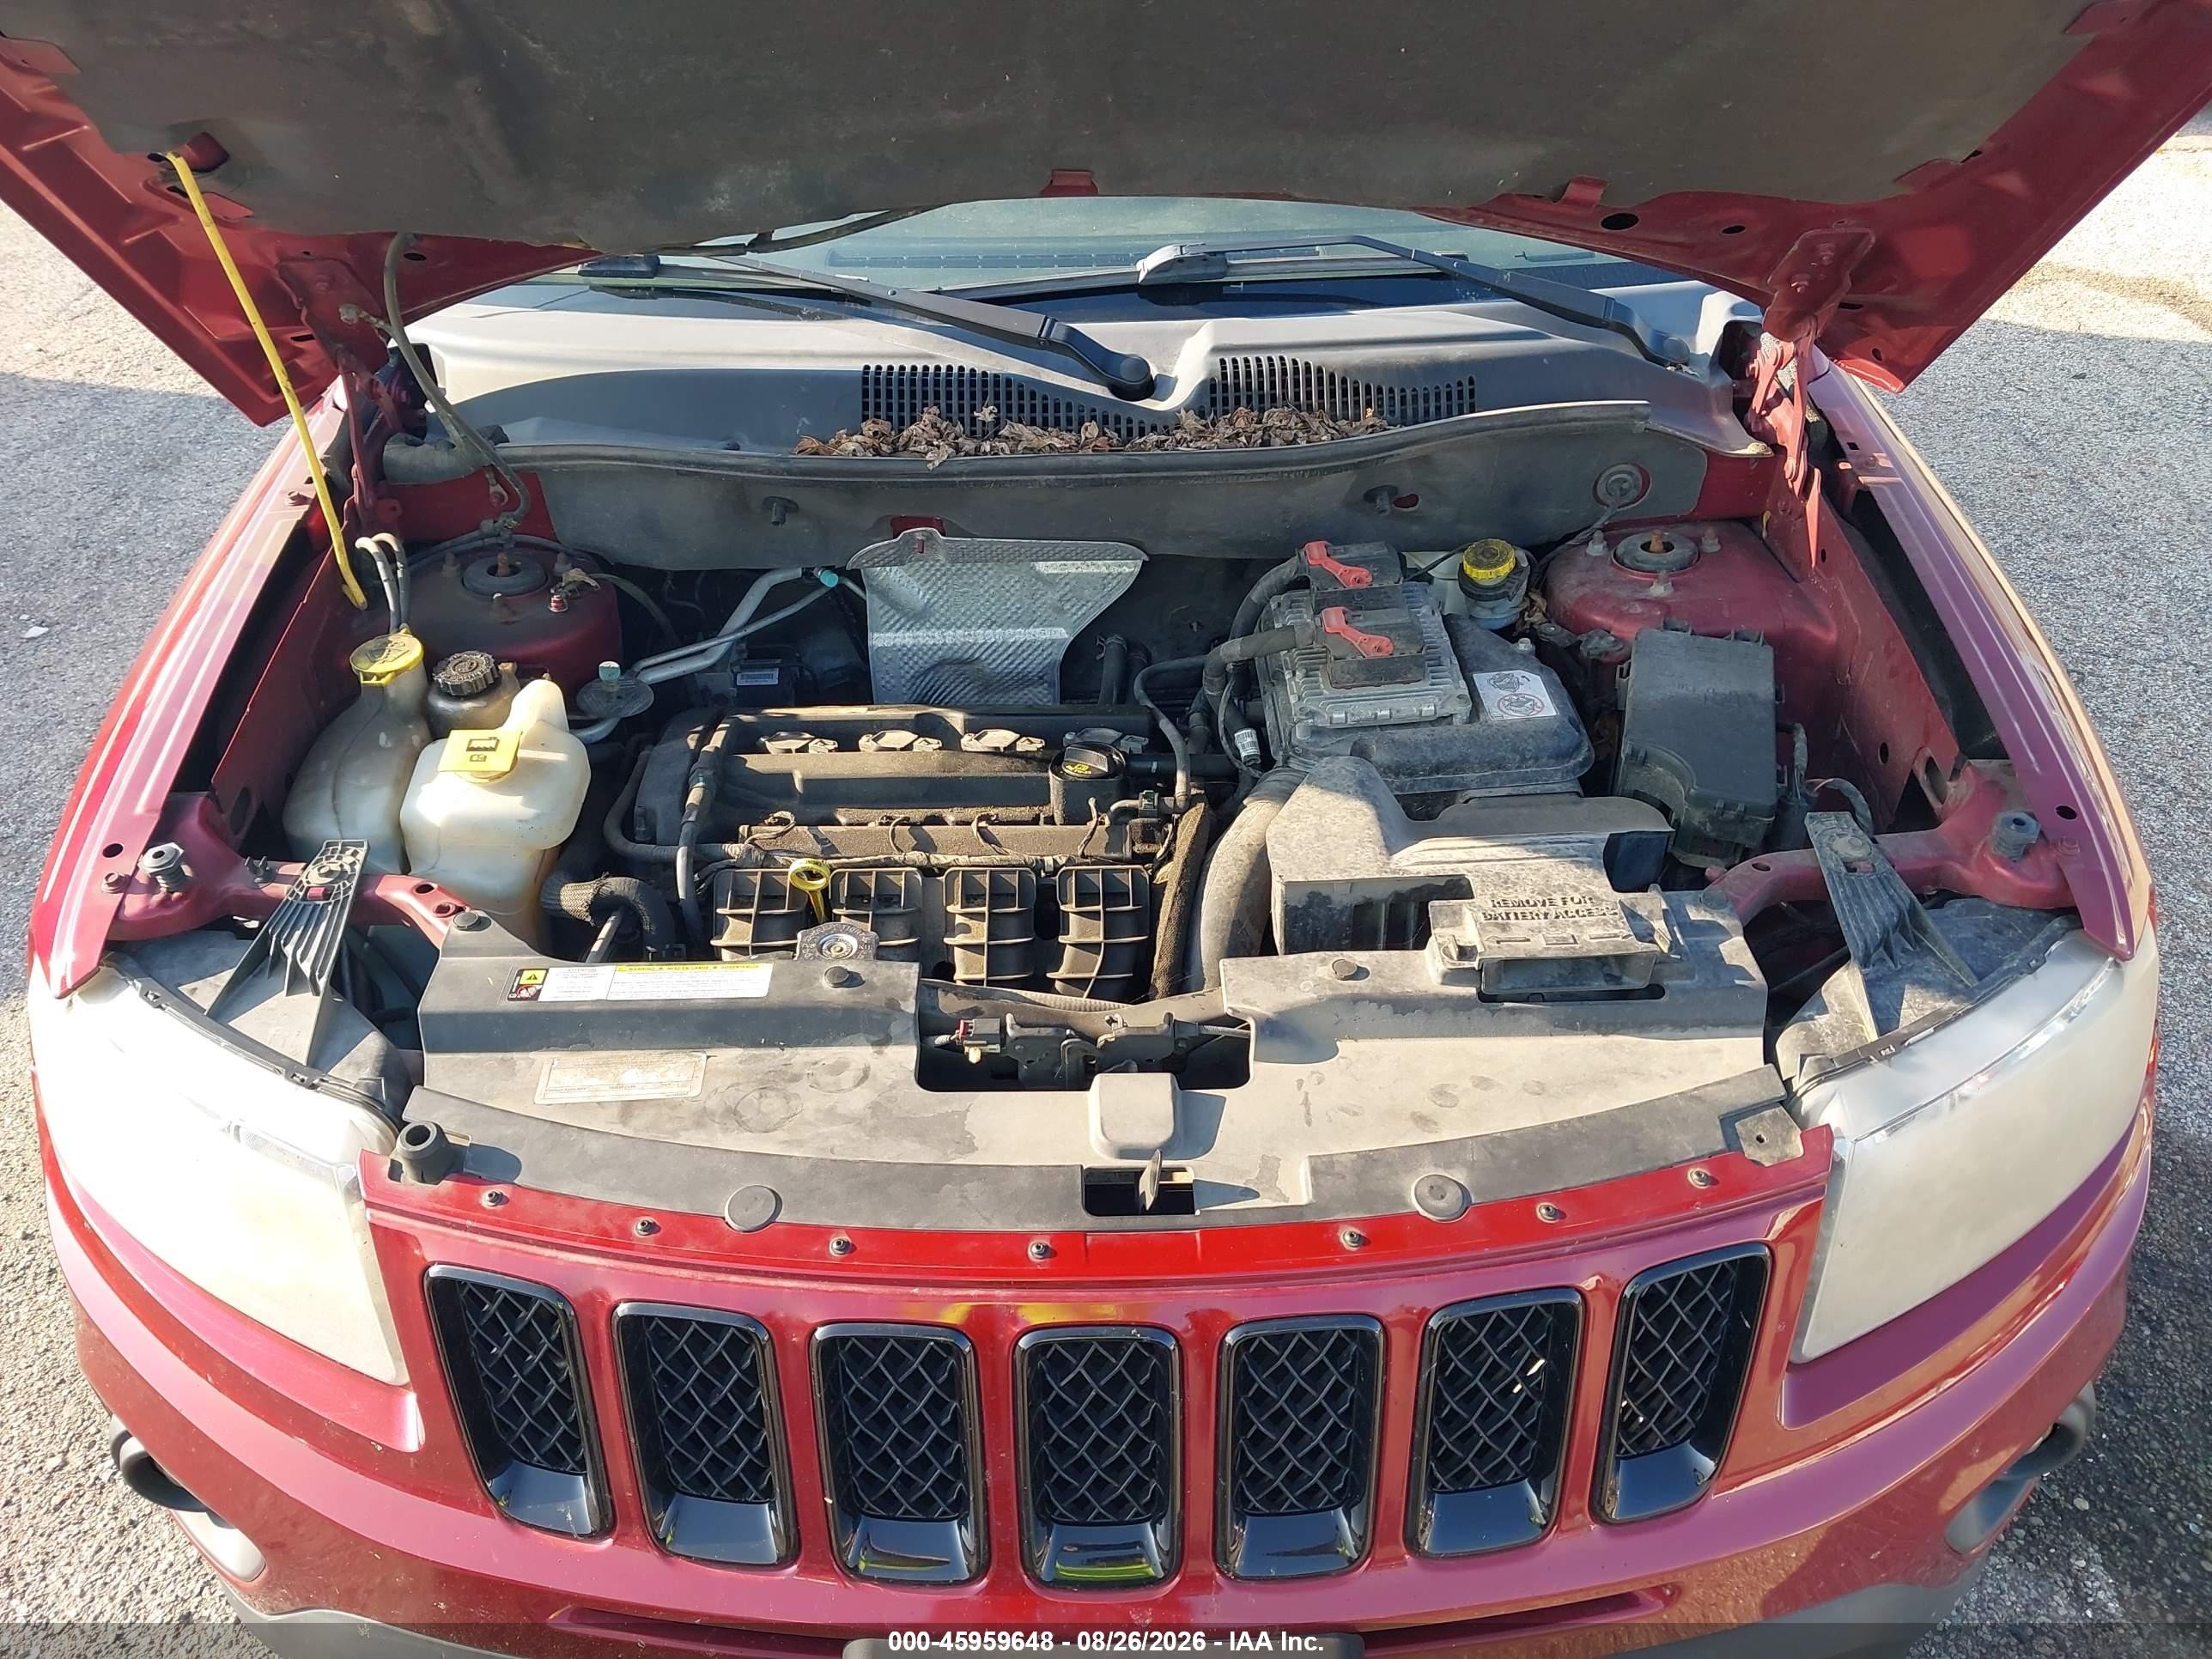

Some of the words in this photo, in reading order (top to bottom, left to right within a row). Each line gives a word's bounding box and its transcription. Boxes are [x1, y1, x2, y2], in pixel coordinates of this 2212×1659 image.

[1491, 897, 1558, 908] REMOVE
[1560, 896, 1595, 906] FOR
[1481, 910, 1550, 921] BATTERY
[1553, 907, 1620, 920] ACCESS
